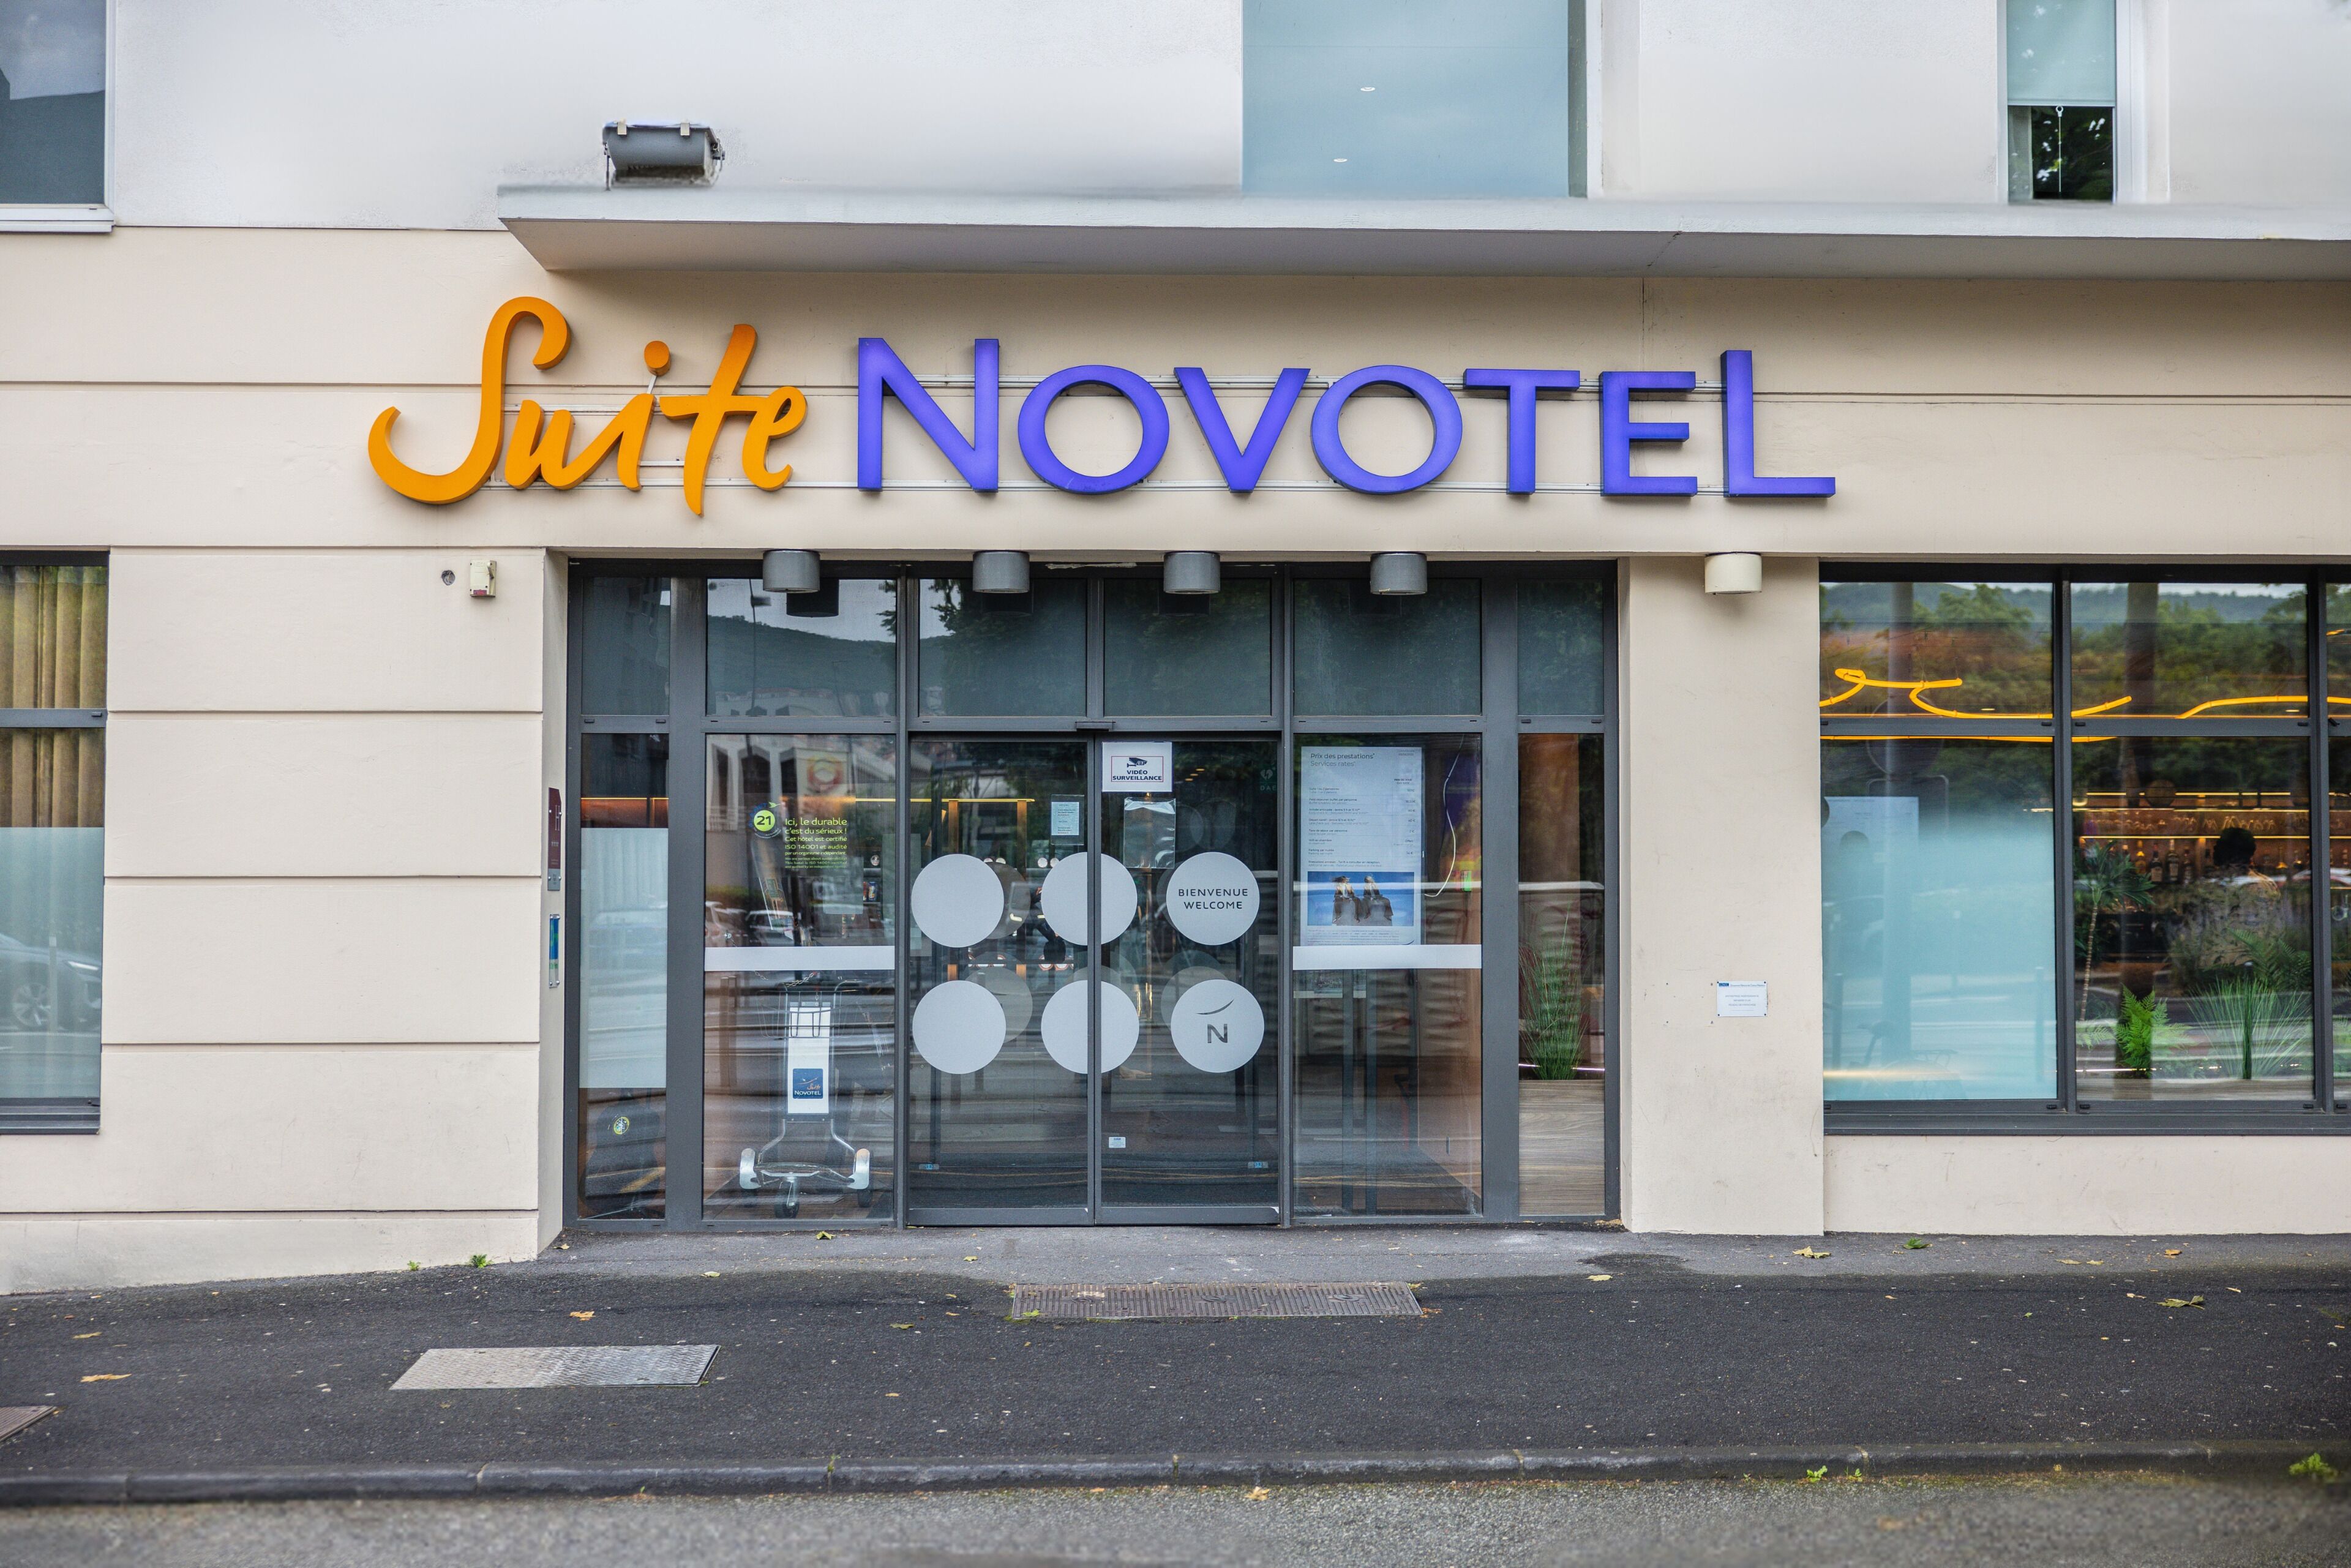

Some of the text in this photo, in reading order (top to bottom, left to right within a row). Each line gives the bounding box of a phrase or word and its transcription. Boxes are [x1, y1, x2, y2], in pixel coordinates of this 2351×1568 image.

[367, 296, 1836, 517] Suite NOVOTEL
[757, 816, 771, 825] 21
[785, 818, 798, 827] Ici,
[1178, 888, 1248, 897] BIENVENUE
[1183, 901, 1243, 910] WELCOME
[1207, 1023, 1228, 1044] N
